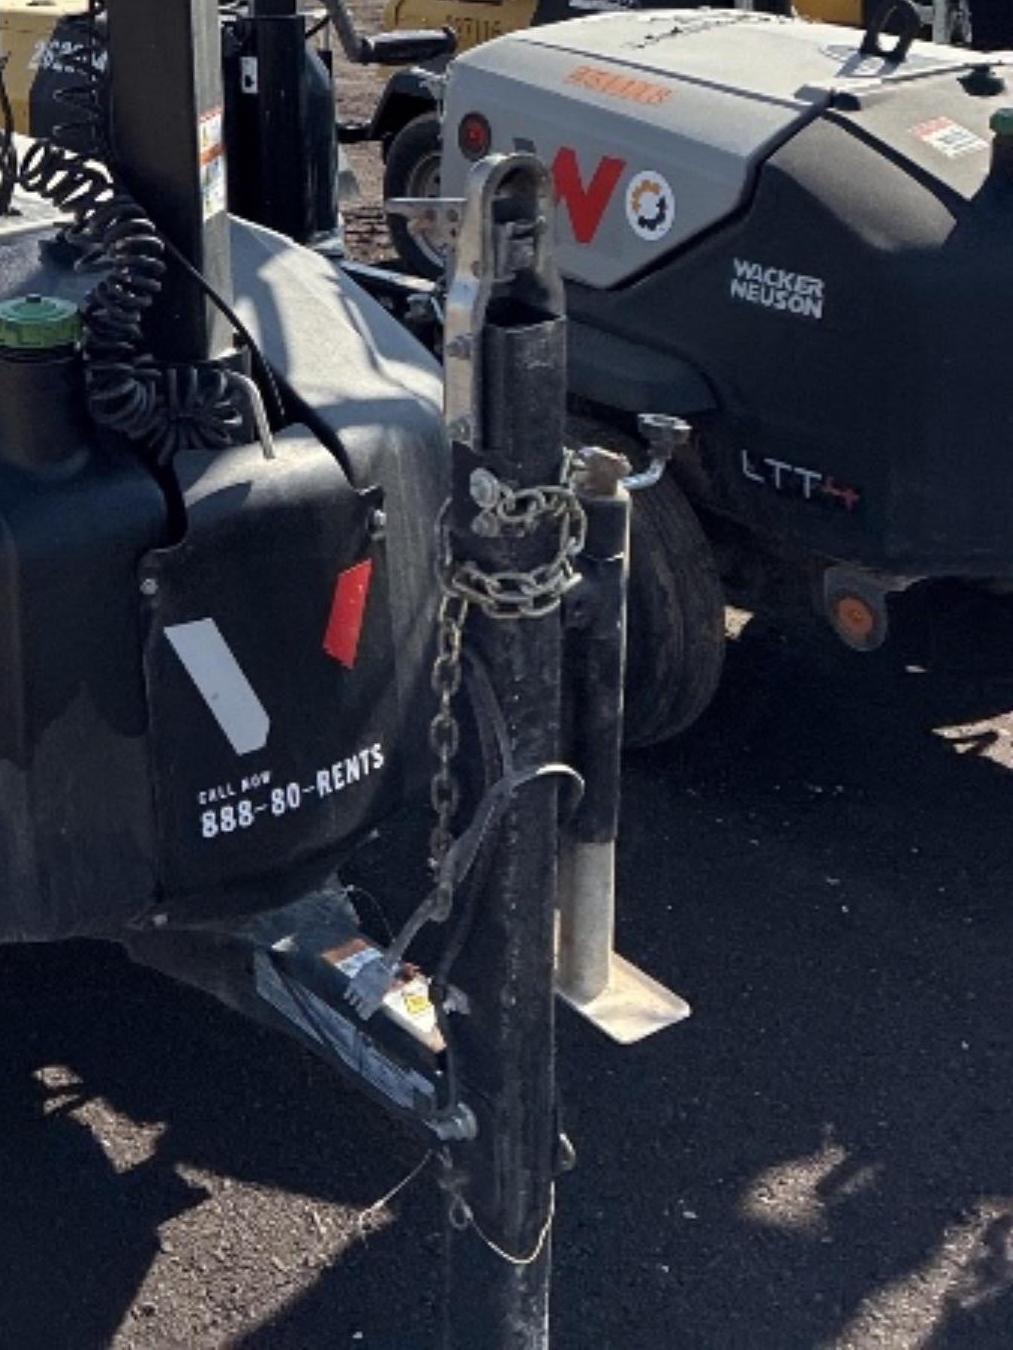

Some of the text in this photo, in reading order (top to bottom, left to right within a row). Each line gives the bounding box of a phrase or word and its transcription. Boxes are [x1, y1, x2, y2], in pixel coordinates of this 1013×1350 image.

[733, 258, 825, 298] WACKER
[731, 280, 822, 319] NEUSON
[198, 770, 271, 805] CALL NOW
[201, 742, 384, 838] 888-80-RENTS
